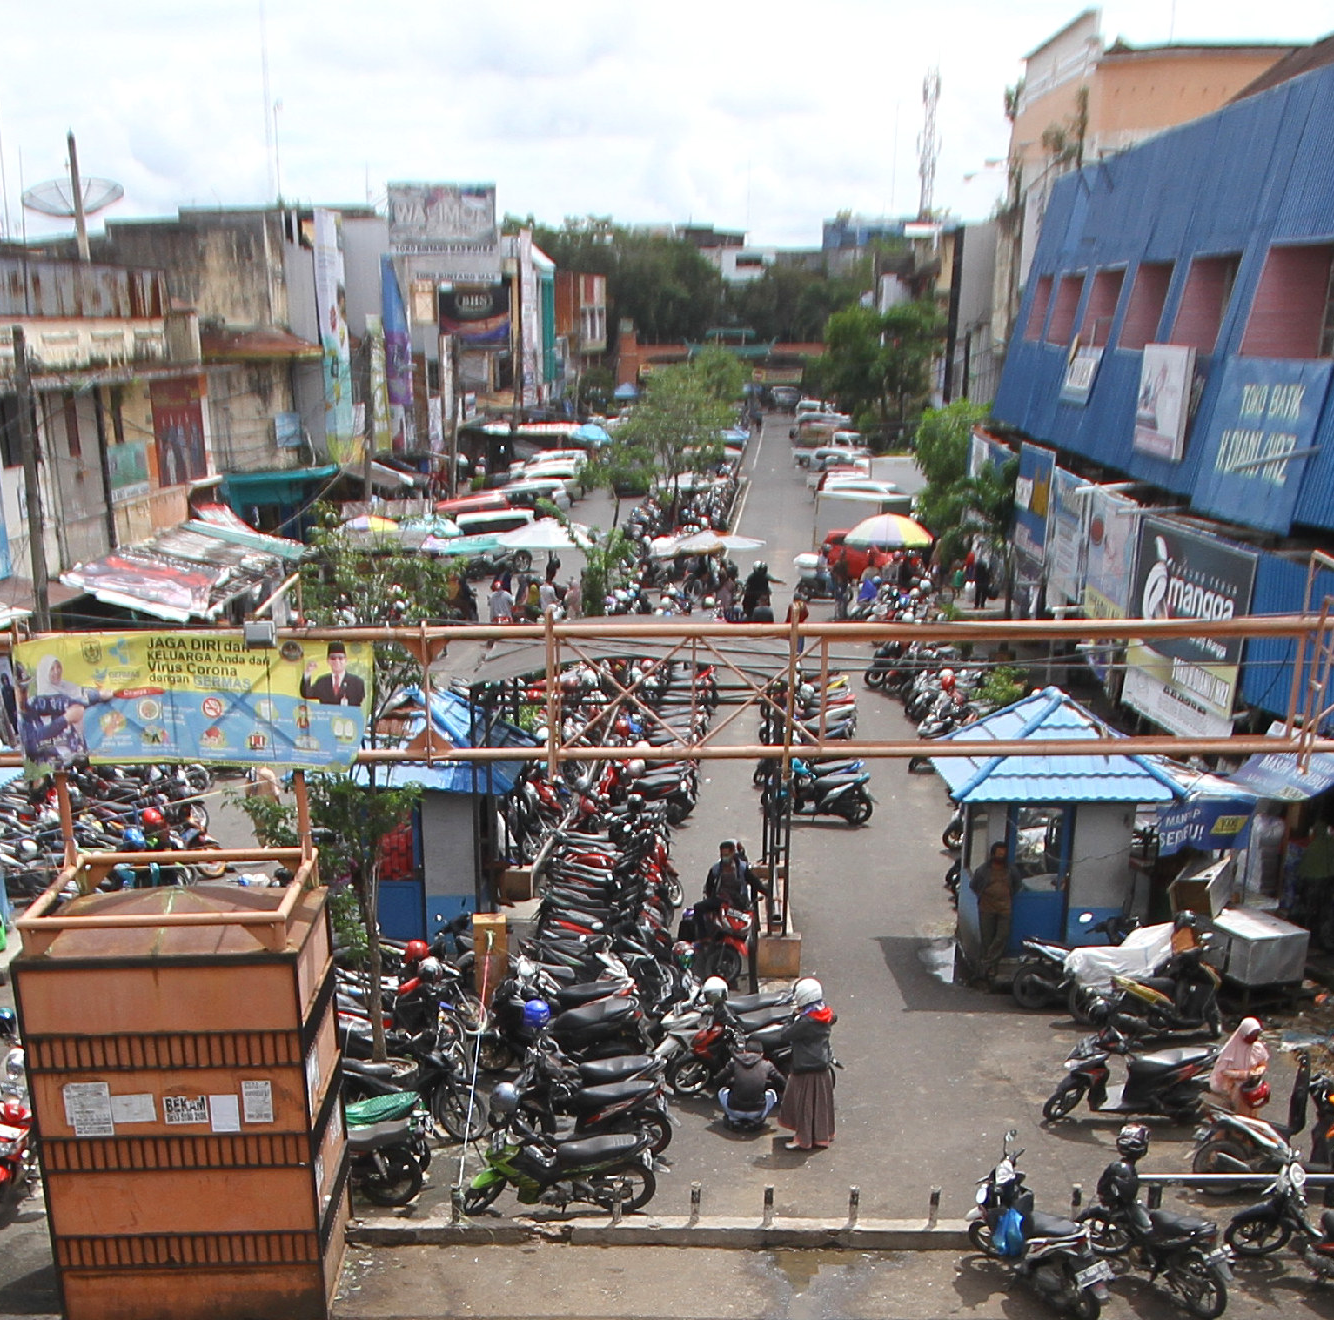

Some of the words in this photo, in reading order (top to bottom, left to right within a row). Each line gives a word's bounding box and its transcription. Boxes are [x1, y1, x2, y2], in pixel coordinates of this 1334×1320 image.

[1267, 384, 1306, 420] BATIK
[148, 637, 187, 650] JAGA
[190, 638, 221, 652] DIRI
[147, 650, 212, 662] KELUARGA
[216, 652, 246, 665] Anda
[147, 660, 183, 674] Virus
[187, 662, 238, 676] Corona
[193, 675, 252, 690] GERMAS
